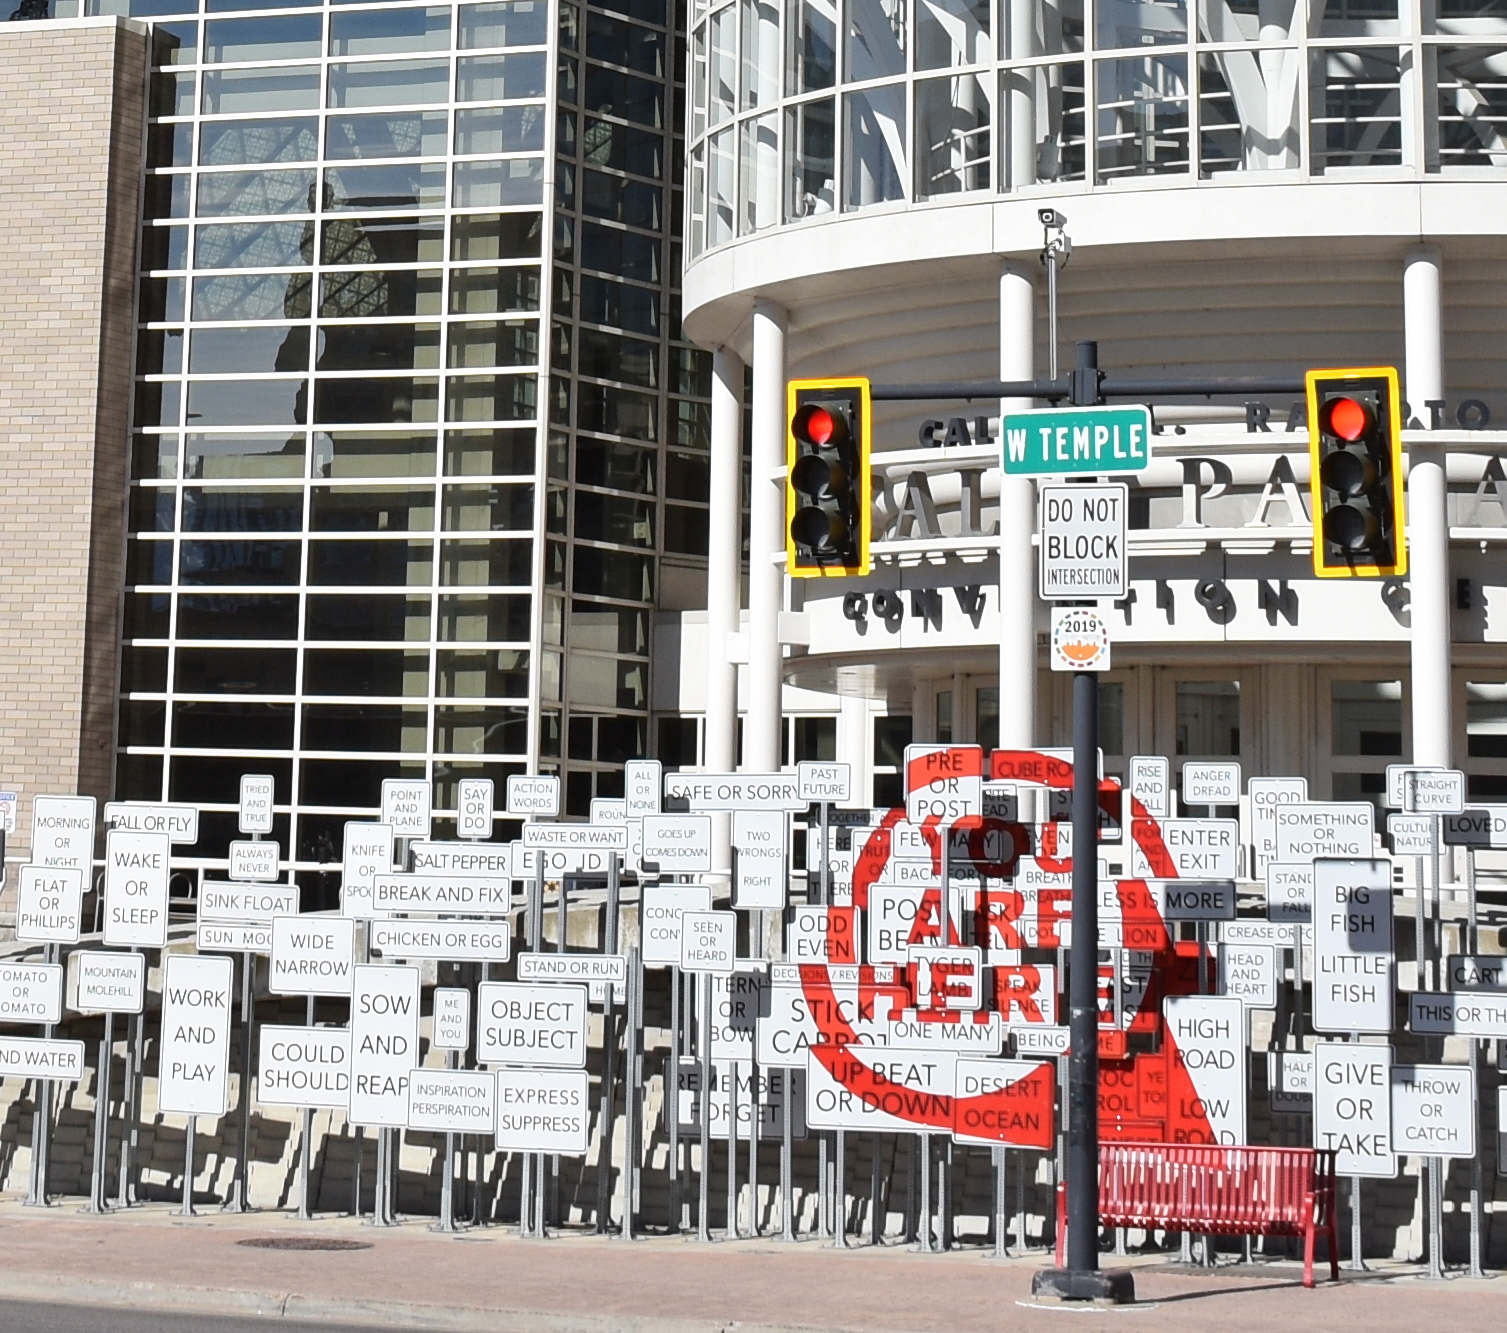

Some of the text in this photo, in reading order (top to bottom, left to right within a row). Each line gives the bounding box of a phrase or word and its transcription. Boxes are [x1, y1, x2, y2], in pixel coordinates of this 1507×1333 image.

[1007, 423, 1143, 462] W TEMPLE
[1048, 498, 1119, 522] DO NOT
[1048, 535, 1118, 559] BLOCK
[1048, 568, 1120, 585] INTERSECTION
[1065, 621, 1096, 633] 2019
[927, 754, 963, 771] PRE
[1138, 766, 1161, 777] RISE
[1193, 771, 1230, 780] ANGER
[245, 785, 269, 794] TRIED
[514, 784, 552, 793] ACTION
[803, 784, 844, 795] FUTURE
[1193, 786, 1230, 796] DREAD
[1409, 780, 1457, 790] STRAIGHT
[391, 791, 423, 800] POINT
[514, 798, 552, 808] WORDS
[1414, 795, 1451, 804] CURVE
[918, 800, 971, 817] POST
[37, 817, 90, 829] MORNING
[390, 817, 422, 826] PLANE
[464, 817, 484, 828] DO
[1279, 814, 1368, 825] SOMETHING
[1449, 818, 1506, 832] LOVED
[528, 832, 622, 843] WASTE OR WANT
[658, 830, 696, 838] GOES UP
[1169, 830, 1230, 846] ENTER
[236, 849, 274, 858] ALWAYS
[646, 848, 707, 857] COMES DOWN
[1290, 843, 1359, 854] NOTHING
[115, 853, 161, 868] WAKE
[239, 863, 269, 873] NEVER
[415, 854, 505, 870] SALT PEPPER
[1180, 854, 1220, 870] EXIT
[205, 894, 293, 911] SINK FLOAT
[379, 886, 503, 903] BREAK AND FIX
[1335, 887, 1370, 904] BIG
[799, 915, 847, 933] ODD
[907, 888, 1076, 950] ARE
[1331, 914, 1375, 932] FISH
[694, 922, 722, 933] SEEN
[291, 934, 334, 949] WIDE
[688, 950, 727, 961] HEARD
[1228, 953, 1263, 965] HEAD
[276, 960, 348, 976] NARROW
[524, 961, 619, 974] STAND OR RUN
[914, 956, 974, 974] TYGER
[1321, 956, 1386, 974] LITTLE
[85, 968, 137, 979] MOUNTAIN
[774, 969, 827, 978] DECISIONS
[839, 970, 893, 981] REVISIONS
[87, 985, 133, 996] MOLEHILL
[1331, 985, 1375, 1002] FISH
[360, 994, 411, 1015] SOW
[491, 1000, 574, 1021] OBJECT
[791, 999, 874, 1023] STICK
[1416, 1005, 1452, 1020] THIS
[1456, 1007, 1481, 1022] OR
[895, 1023, 993, 1041] ONE MANY
[1178, 1019, 1229, 1039] HIGH
[486, 1027, 578, 1049] SUBJECT
[272, 1043, 344, 1063] COULD
[1175, 1050, 1235, 1069] ROAD
[832, 1062, 937, 1086] UP BEAT
[1325, 1062, 1384, 1085] GIVE
[417, 1085, 486, 1098] INSPIRATION
[965, 1076, 1040, 1097] DESERT
[504, 1088, 579, 1105] EXPRESS
[816, 1090, 951, 1118] OR DOWN
[412, 1104, 490, 1117] PERSPIRATION
[1181, 1099, 1229, 1118] LOW
[1336, 1098, 1373, 1120] OR
[503, 1115, 580, 1132] SUPPRESS
[964, 1108, 1039, 1131] OCEAN
[1405, 1127, 1457, 1141] CATCH
